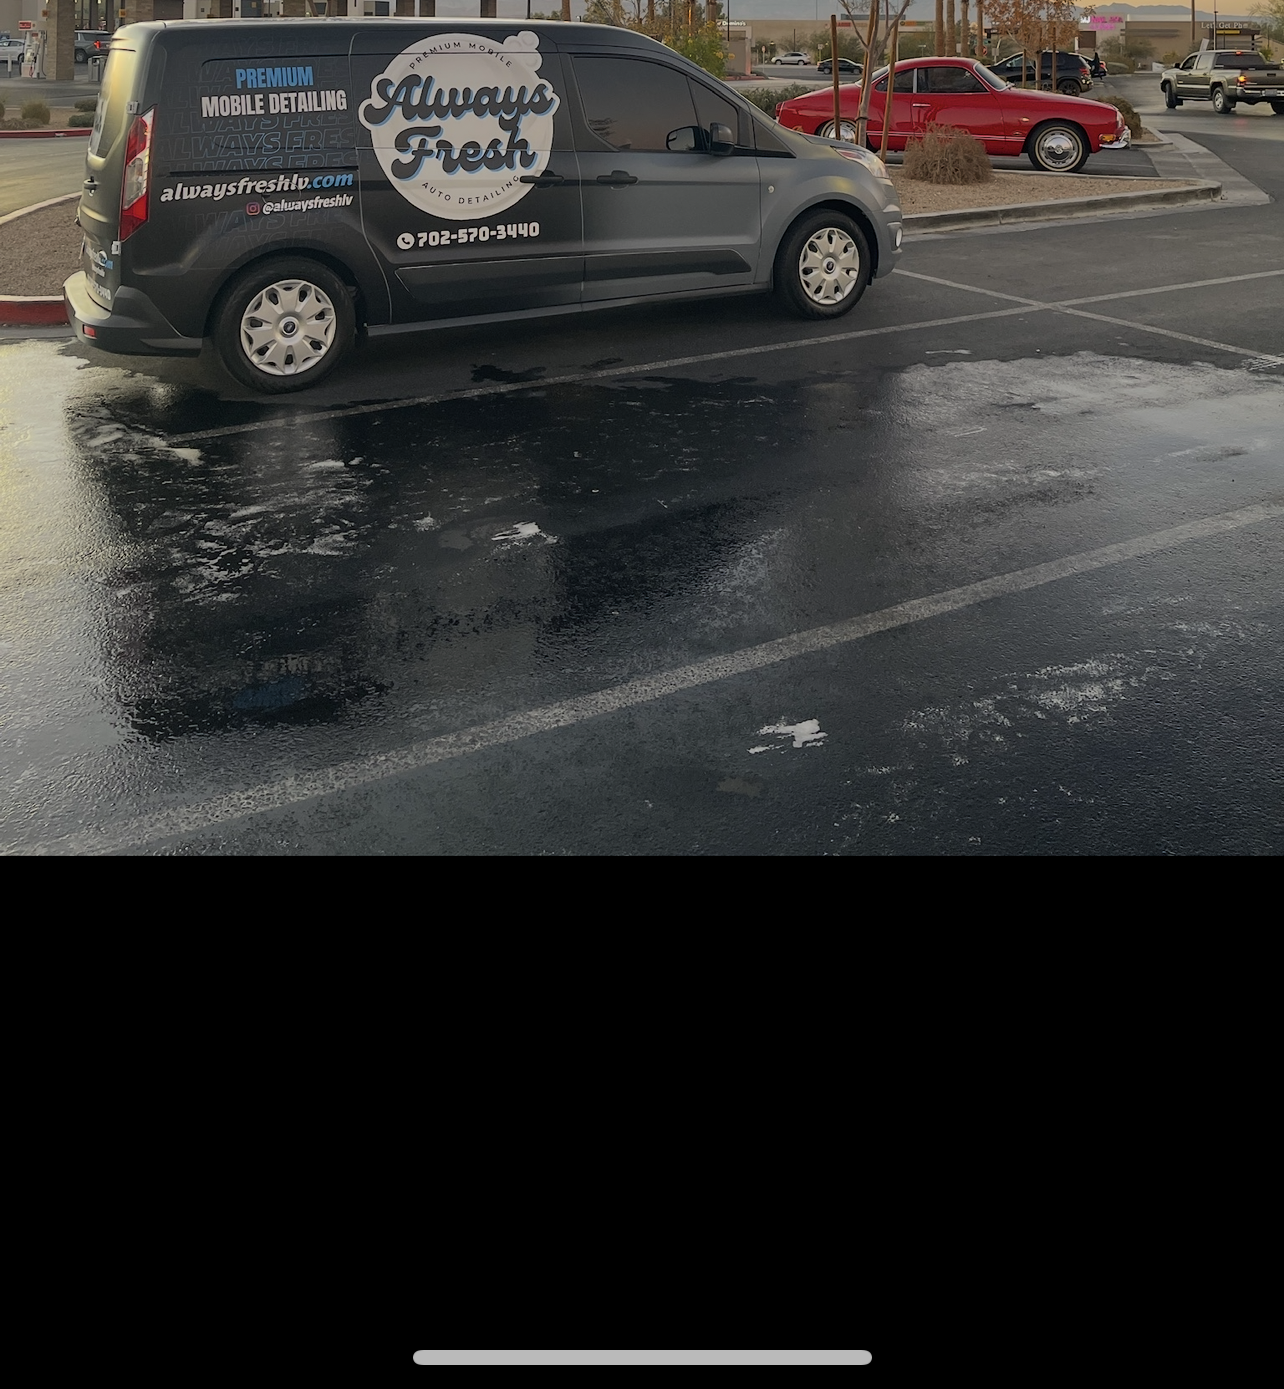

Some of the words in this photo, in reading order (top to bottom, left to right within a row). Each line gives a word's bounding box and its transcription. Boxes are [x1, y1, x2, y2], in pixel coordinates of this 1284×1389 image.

[409, 41, 462, 70] PREMIUM
[468, 42, 513, 68] MOBILE
[235, 66, 314, 89] PREMIUM
[201, 93, 265, 118] MOBILE
[268, 89, 348, 114] DETAILING
[363, 73, 556, 132] Always
[391, 124, 538, 181] Fresh
[160, 173, 354, 203] alwaysfreshlv.com
[421, 182, 452, 202] AUTO
[458, 175, 520, 205] DETAILING
[262, 194, 354, 215] @alwaysfreshlv
[417, 221, 540, 248] 702-570-3440
